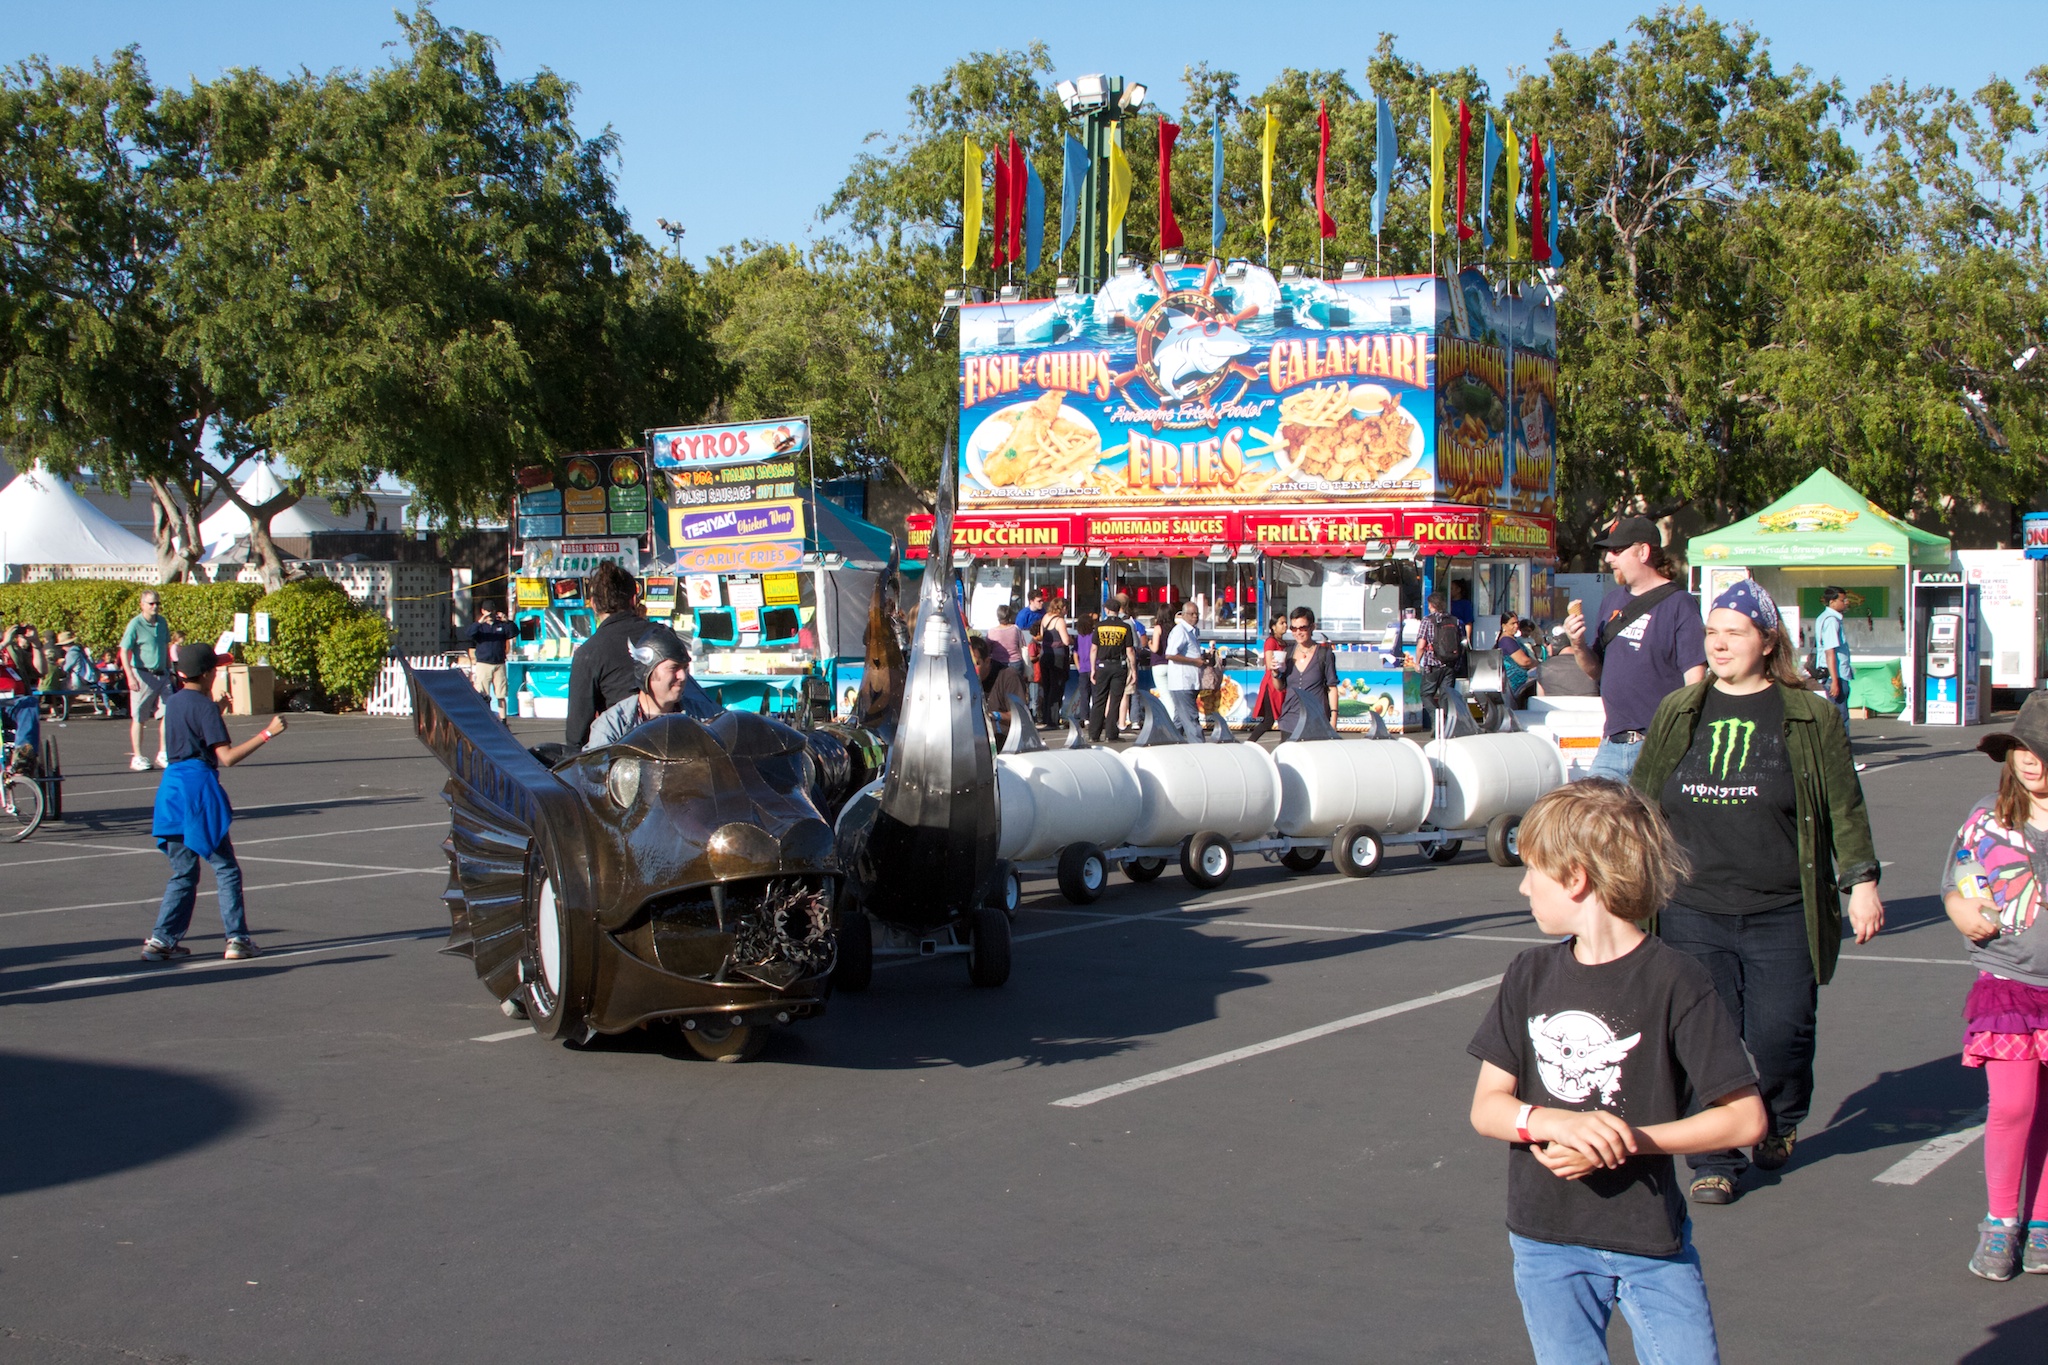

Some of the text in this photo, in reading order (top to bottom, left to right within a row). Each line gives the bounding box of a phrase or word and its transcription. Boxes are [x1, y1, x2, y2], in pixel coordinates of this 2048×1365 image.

[1269, 333, 1428, 392] CALAMARI
[1437, 335, 1505, 400] FRIED VEGGIES
[964, 350, 1110, 408] FISH & CHIPS
[1178, 403, 1216, 421] Fried
[670, 430, 750, 461] GYROS
[1128, 427, 1244, 488] FRIES
[1438, 424, 1470, 481] ONION
[1474, 431, 1505, 488] RINGS
[673, 462, 795, 487] HOT DOG ITALIAN SAUSAGE
[675, 482, 795, 504] POLISH SAUSAGE HOT LINK
[969, 487, 1101, 498] ALASKAN POLLOCK
[1271, 480, 1421, 492] RINGS & TENTACLES
[685, 510, 791, 538] TERIYAKI Chicken Wrap
[1773, 509, 1843, 521] SIERRA NEVADA
[954, 528, 1058, 544] ZUCCHINI
[1091, 520, 1223, 534] HOMEMADE SAUCES
[1257, 524, 1383, 542] FRILLY FRIES
[1414, 523, 1481, 541] PICKLES
[1495, 525, 1547, 544] FRENCH FRIES
[563, 543, 617, 553] FRESH SQUEEZED
[1732, 544, 1863, 556] Sierra Nevada Brewing Company
[695, 549, 785, 567] GARLIC FRIES
[1922, 573, 1959, 582] ATM
[1099, 631, 1126, 640] EVENT
[1681, 783, 1758, 798] MONSTER
[1692, 796, 1747, 805] ENERGY
